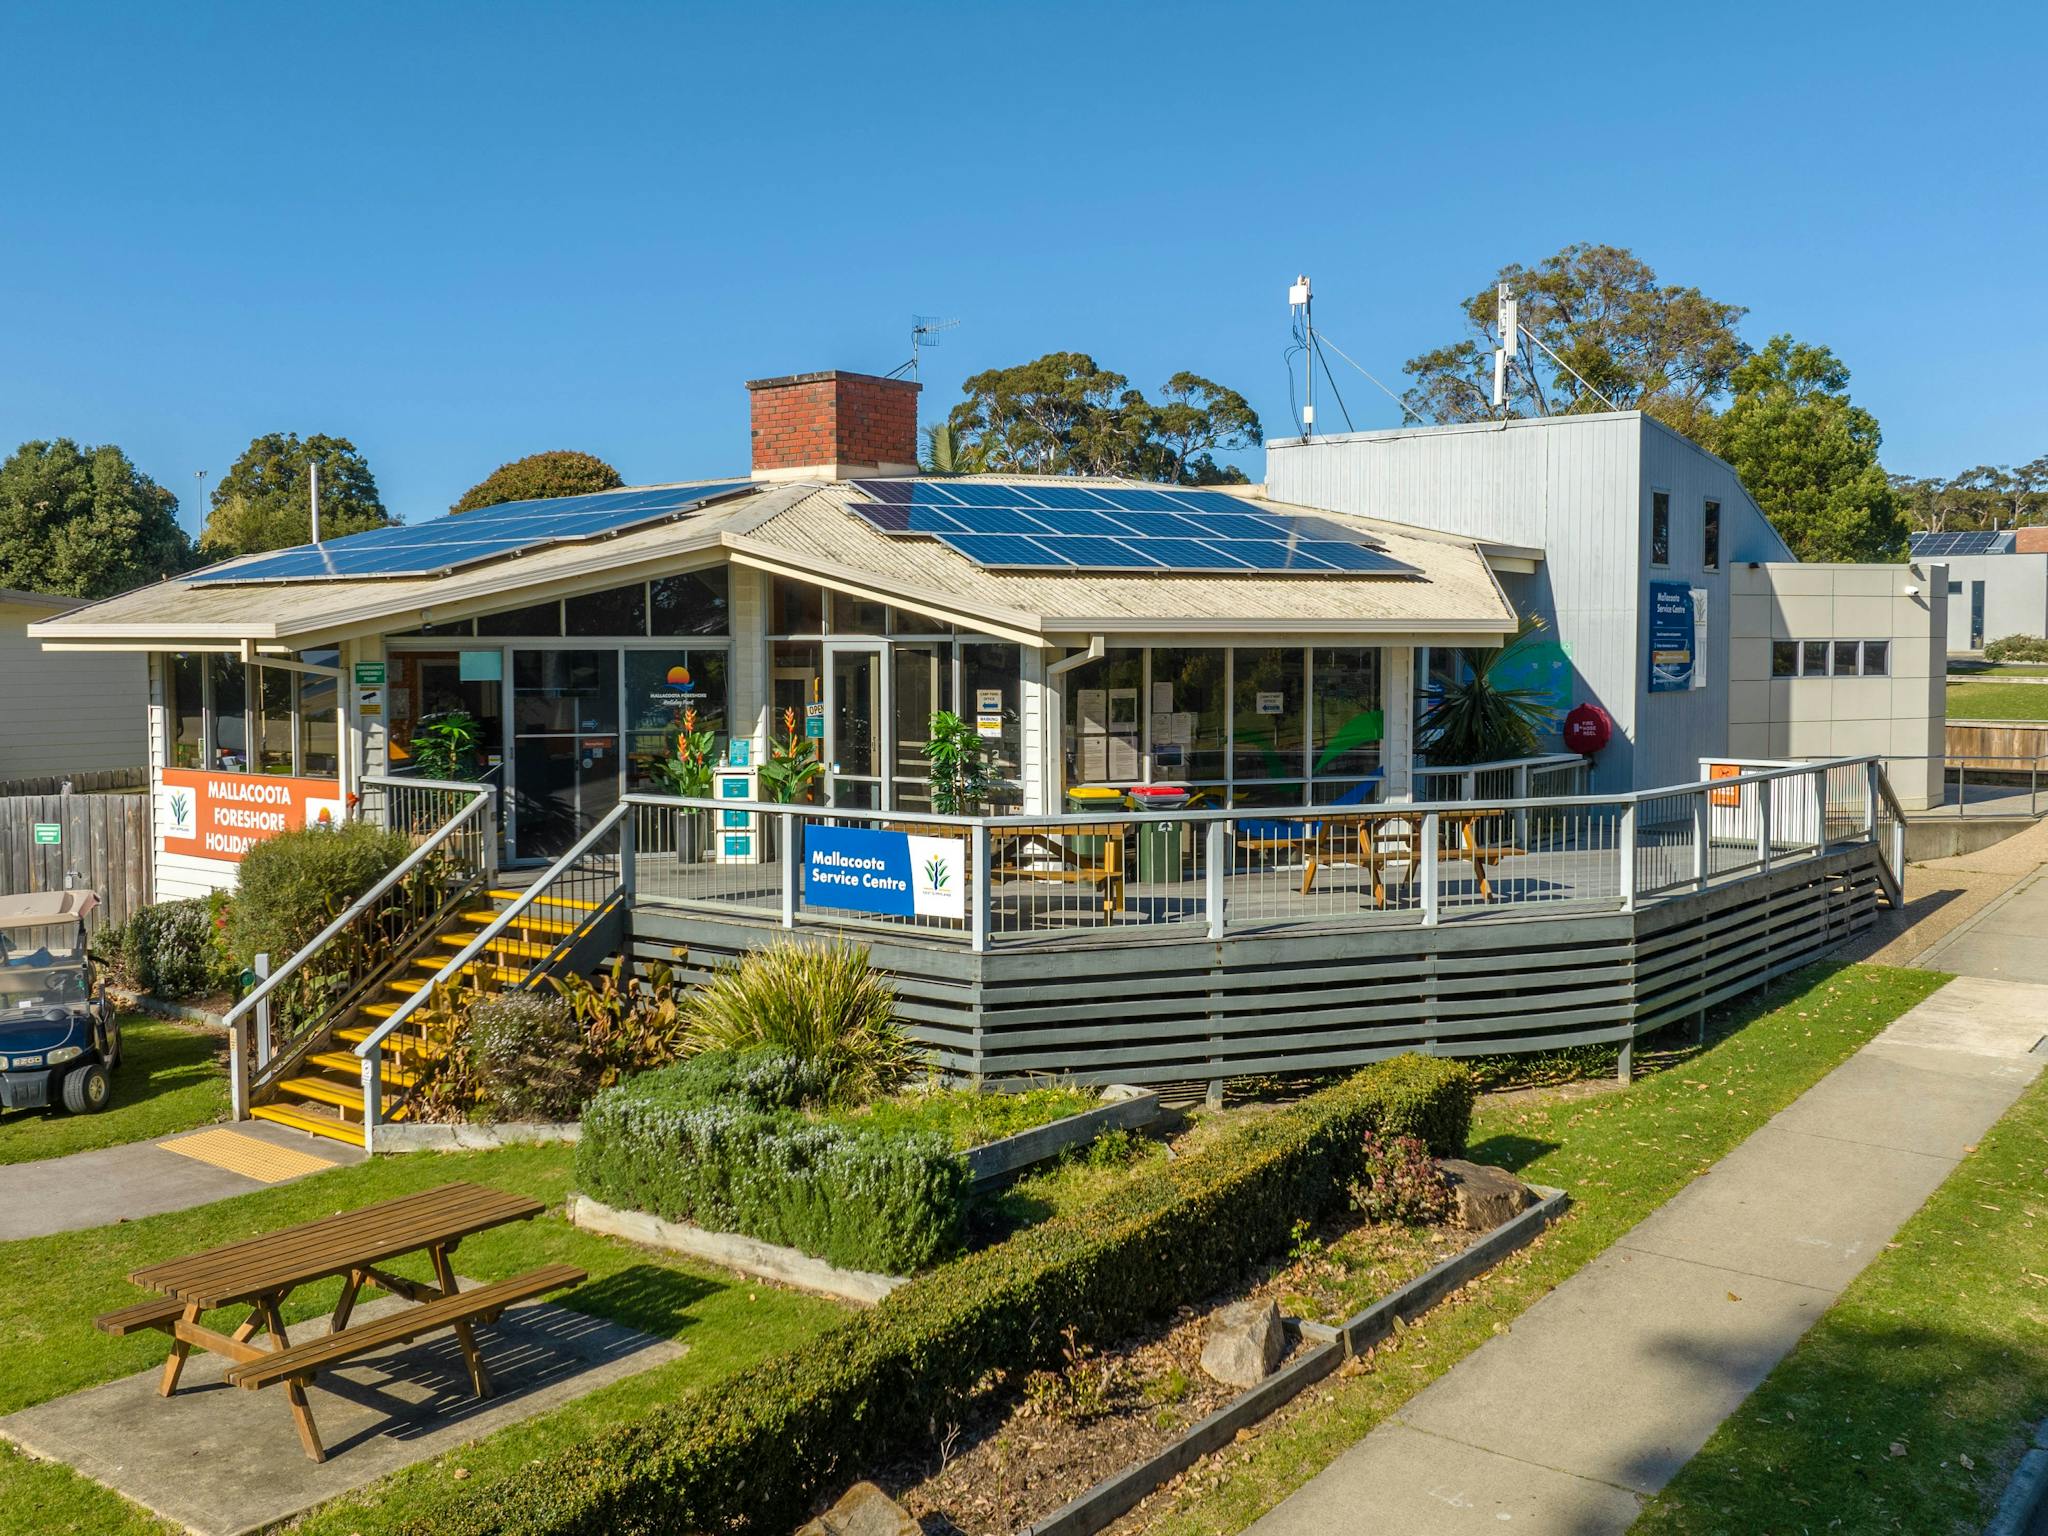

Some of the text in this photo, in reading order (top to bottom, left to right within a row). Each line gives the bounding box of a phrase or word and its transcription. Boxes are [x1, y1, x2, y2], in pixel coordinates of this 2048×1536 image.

[1657, 604, 1685, 614] Service Centre
[208, 780, 291, 805] MALLACOOTA
[214, 808, 285, 831] FORESHORE
[206, 832, 257, 854] HOLIDAY
[812, 850, 885, 871] Mallacoota
[812, 868, 906, 891] Service Centre
